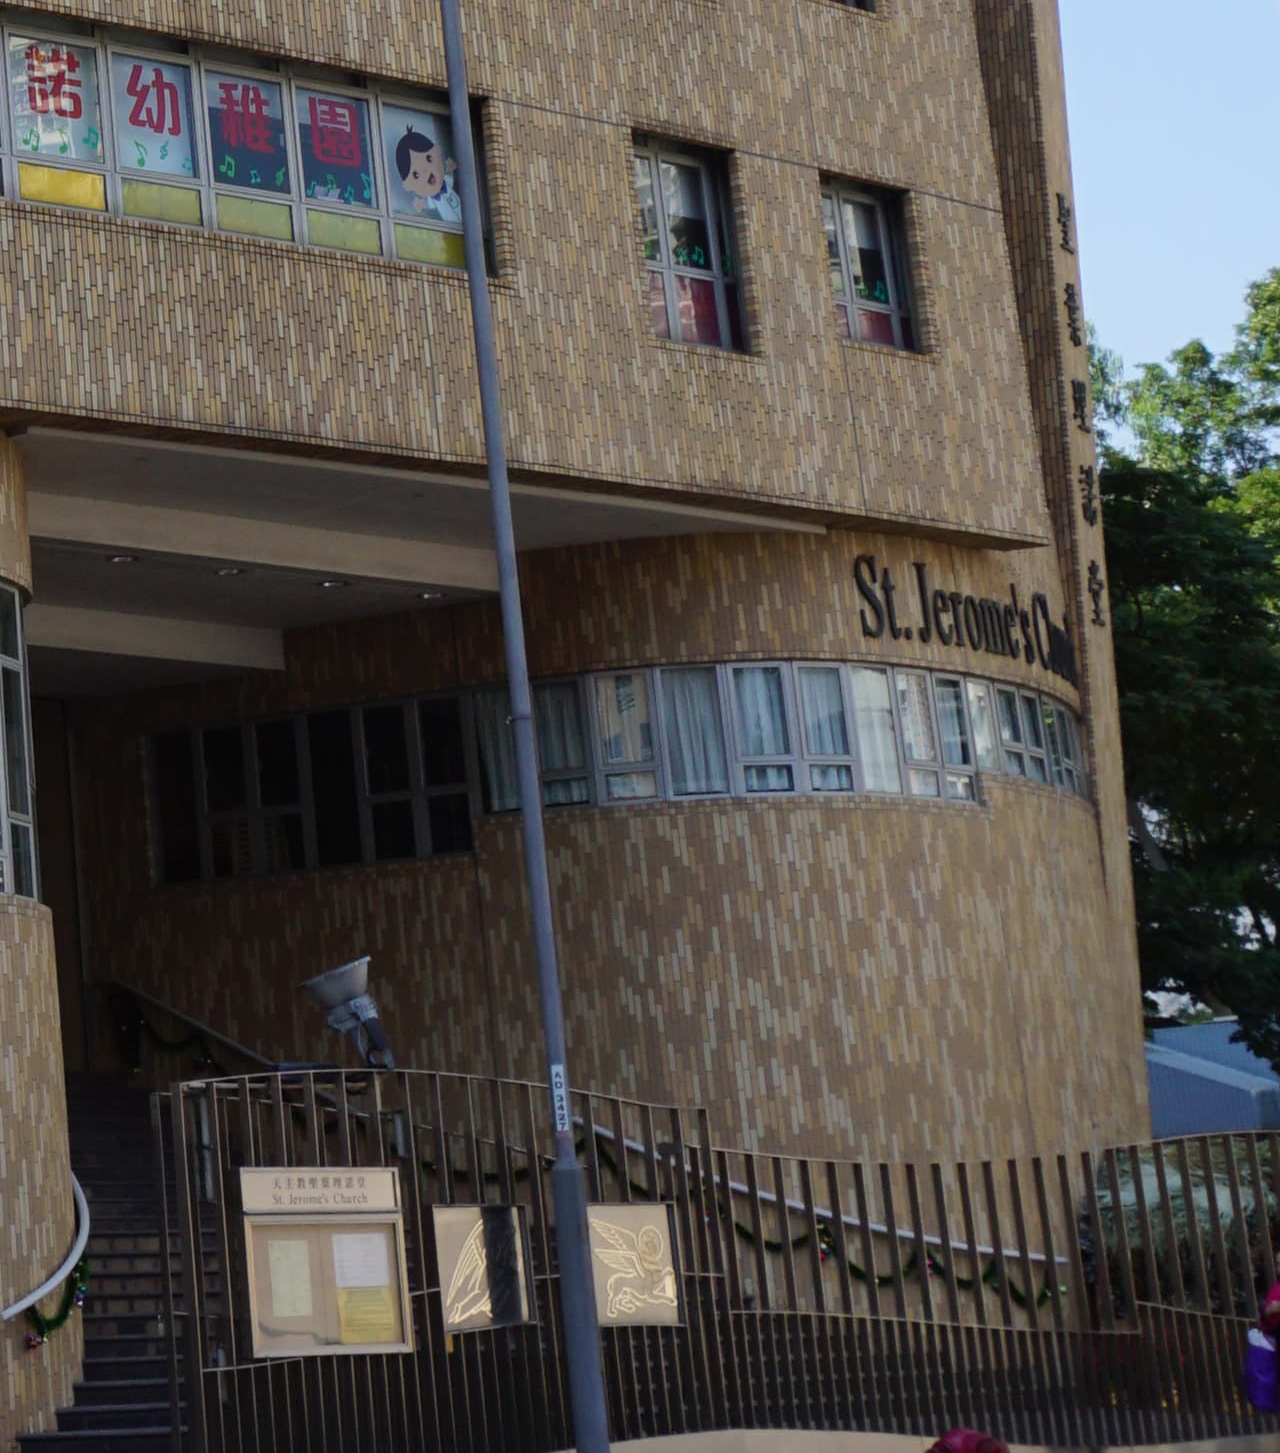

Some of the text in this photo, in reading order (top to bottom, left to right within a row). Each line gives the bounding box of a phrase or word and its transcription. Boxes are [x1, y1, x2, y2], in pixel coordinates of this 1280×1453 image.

[853, 554, 912, 640] St.
[913, 562, 1036, 666] Jerome's
[555, 1094, 567, 1130] 3427
[272, 1193, 369, 1205] St. Jerome's Church
